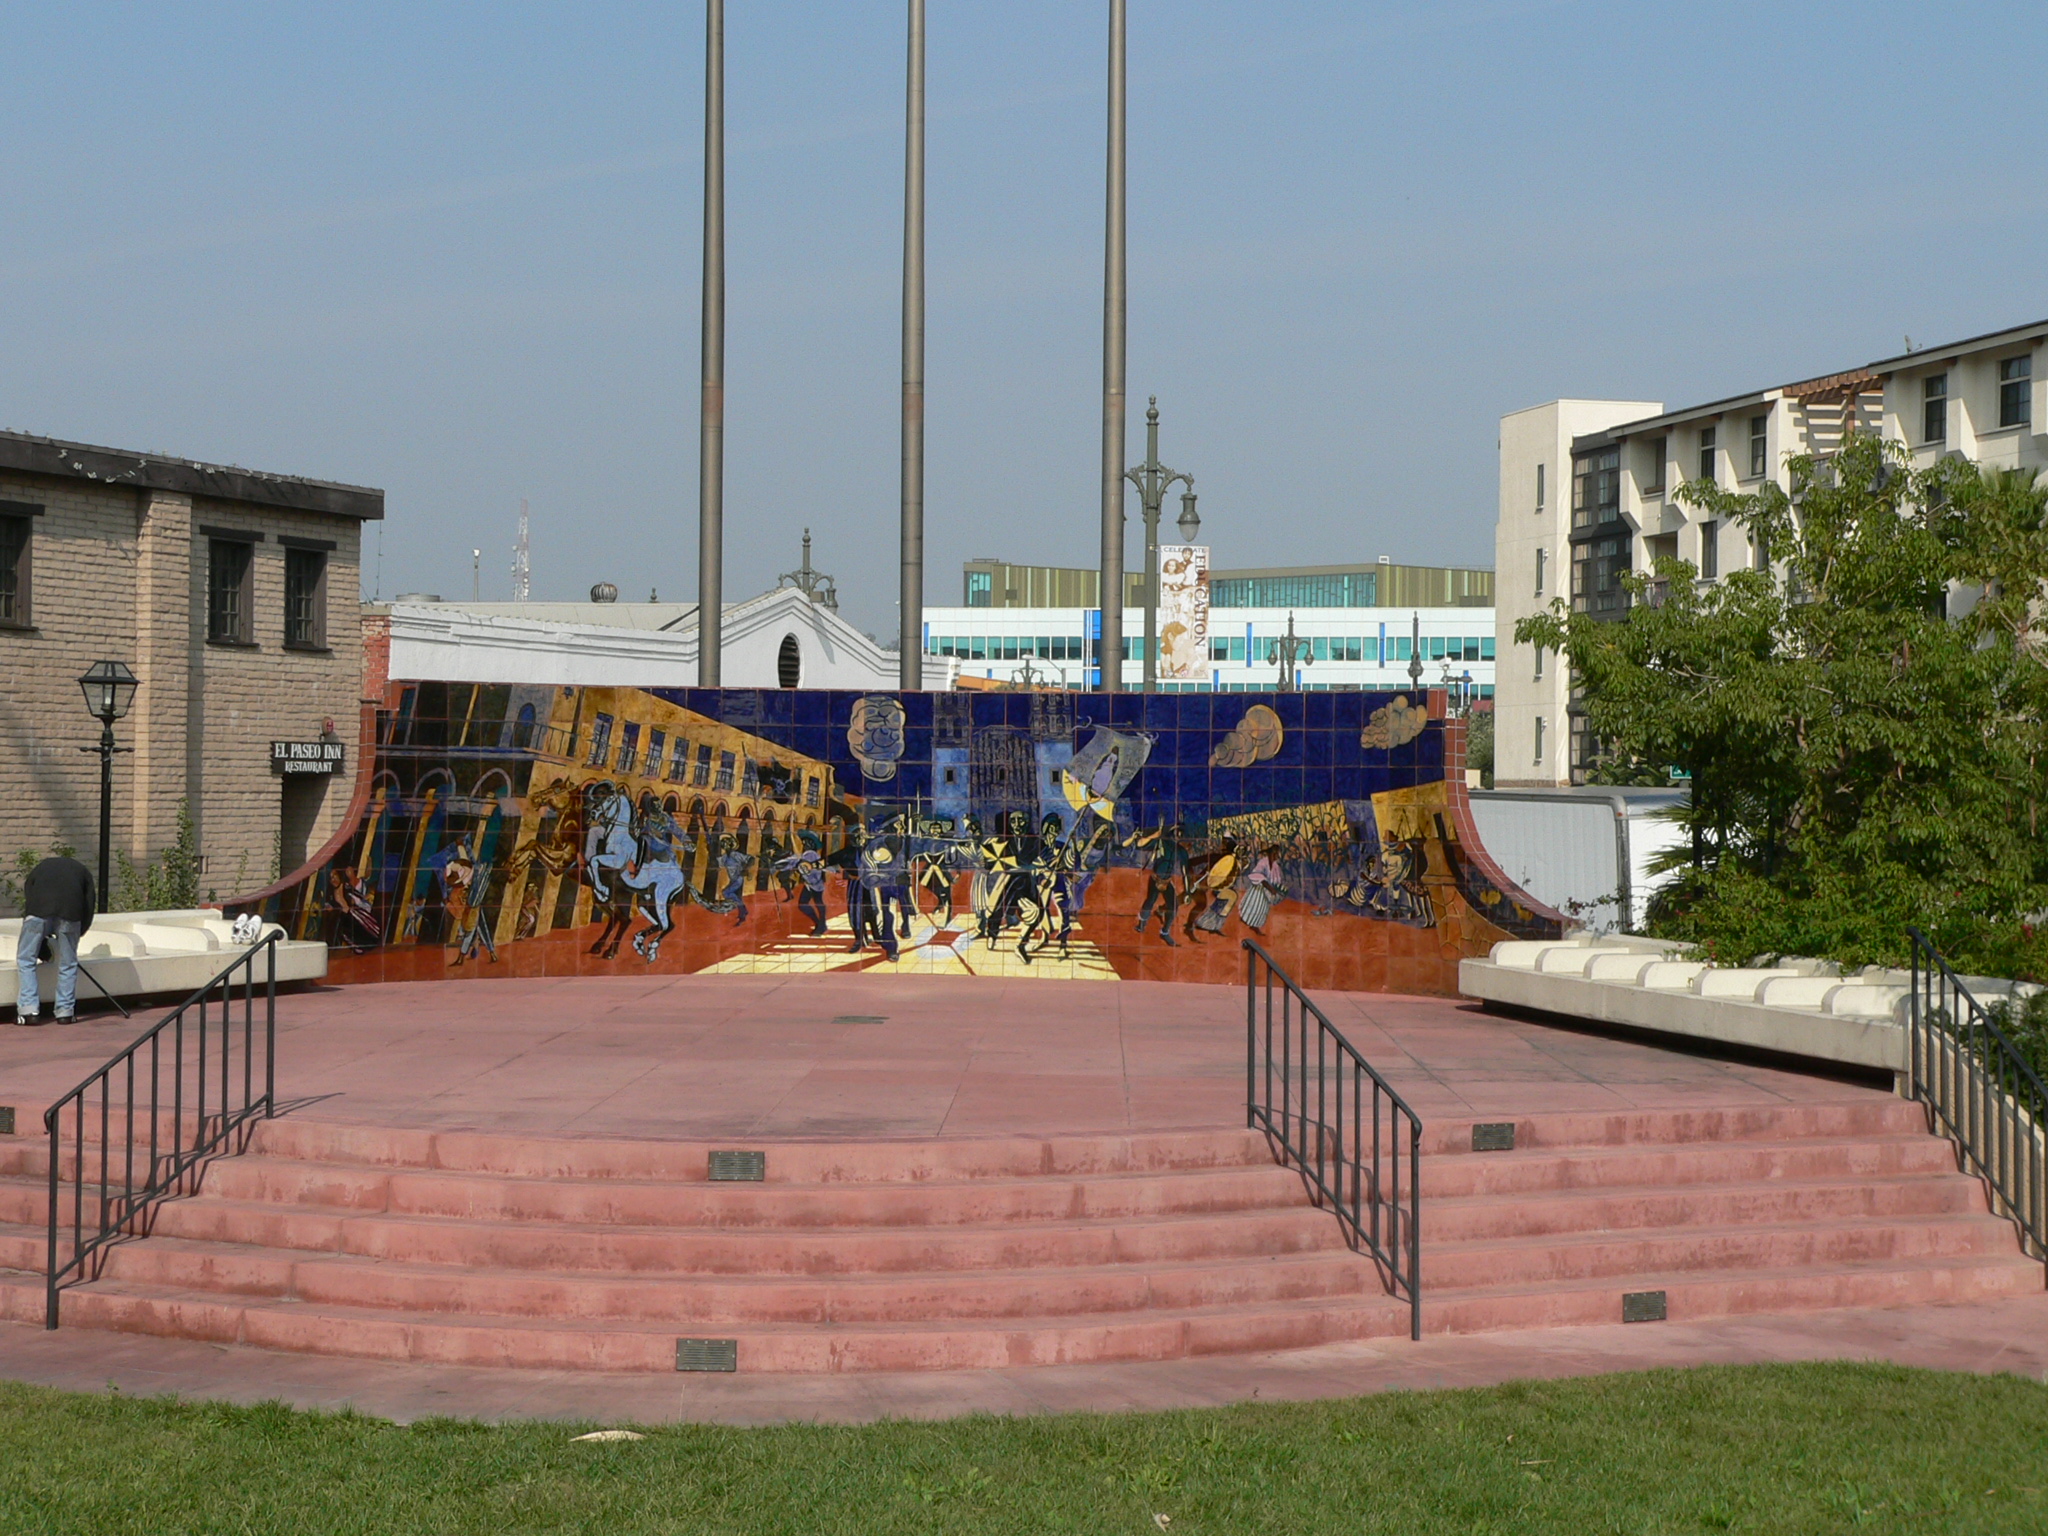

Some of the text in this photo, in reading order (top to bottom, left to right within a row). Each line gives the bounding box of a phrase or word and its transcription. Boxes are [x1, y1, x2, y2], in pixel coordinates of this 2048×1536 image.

[1195, 555, 1206, 647] EDUCATION
[274, 743, 342, 759] EL PASEO INN
[284, 761, 333, 773] RESTAURANT
